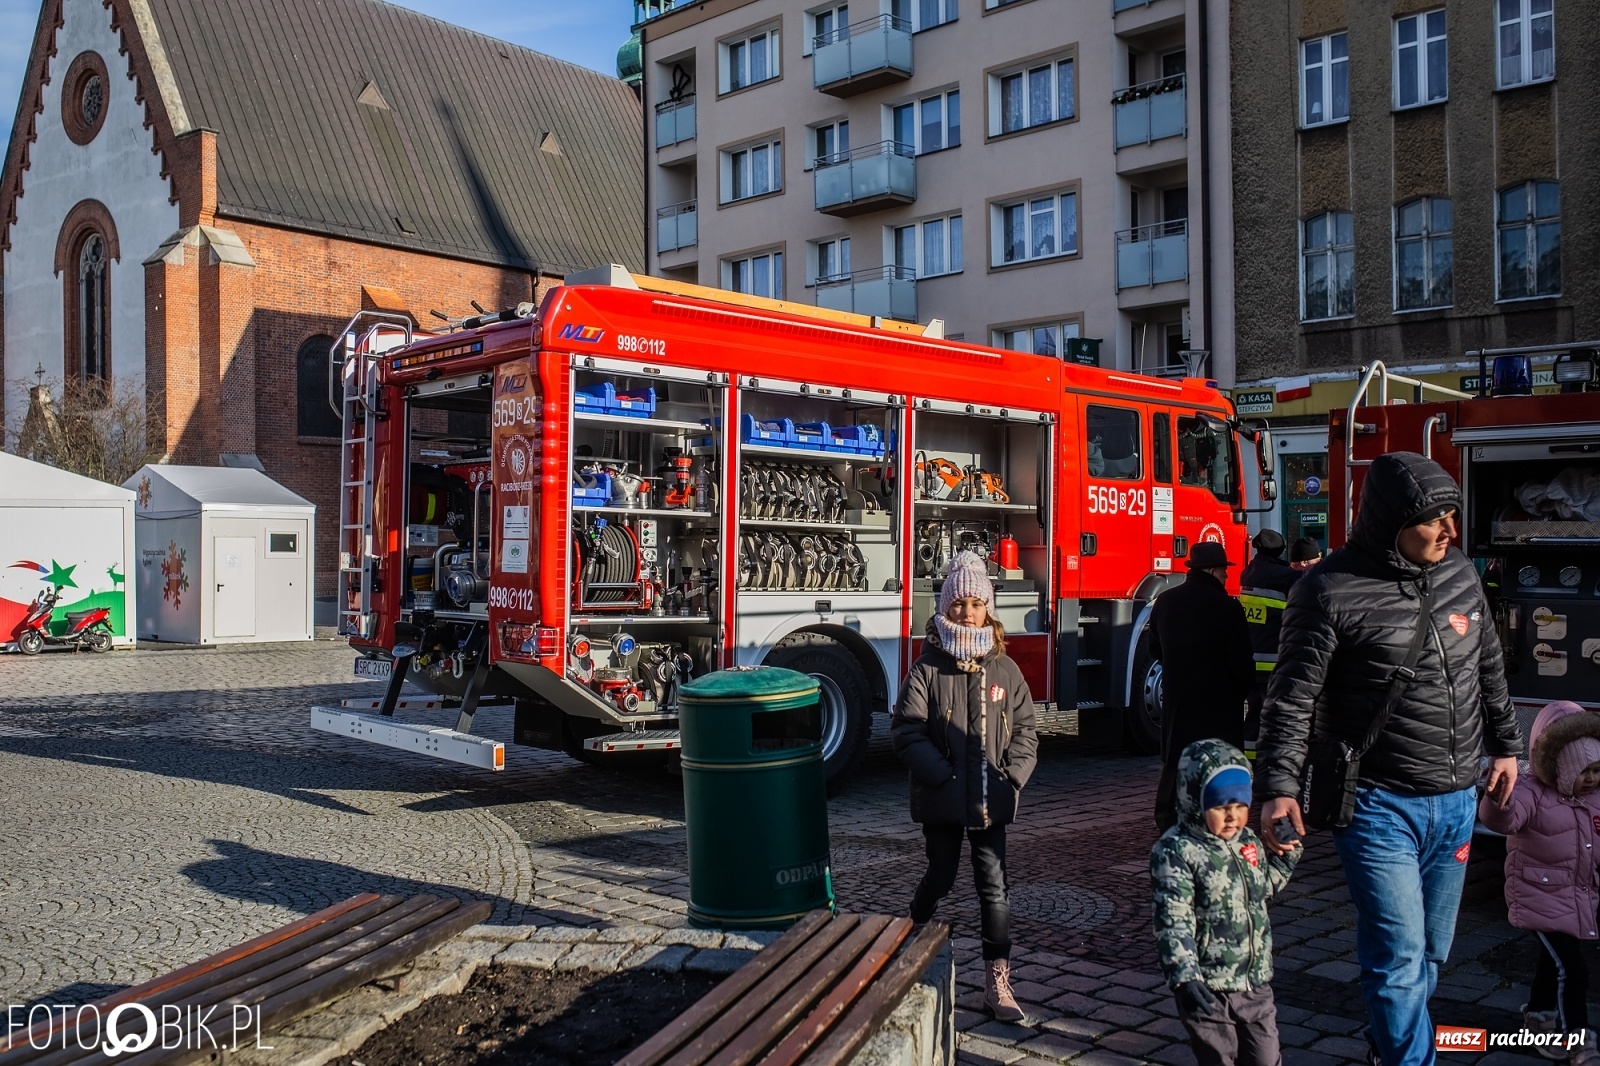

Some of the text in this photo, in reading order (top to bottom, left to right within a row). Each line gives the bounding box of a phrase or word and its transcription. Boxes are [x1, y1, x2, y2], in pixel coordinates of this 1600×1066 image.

[617, 334, 666, 356] 998 112
[1248, 393, 1272, 403] KASA
[1238, 404, 1272, 413] STEFCZYKA
[490, 586, 533, 611] 998 112
[359, 661, 390, 677] SRC 2XX9
[1303, 764, 1313, 814] adidas
